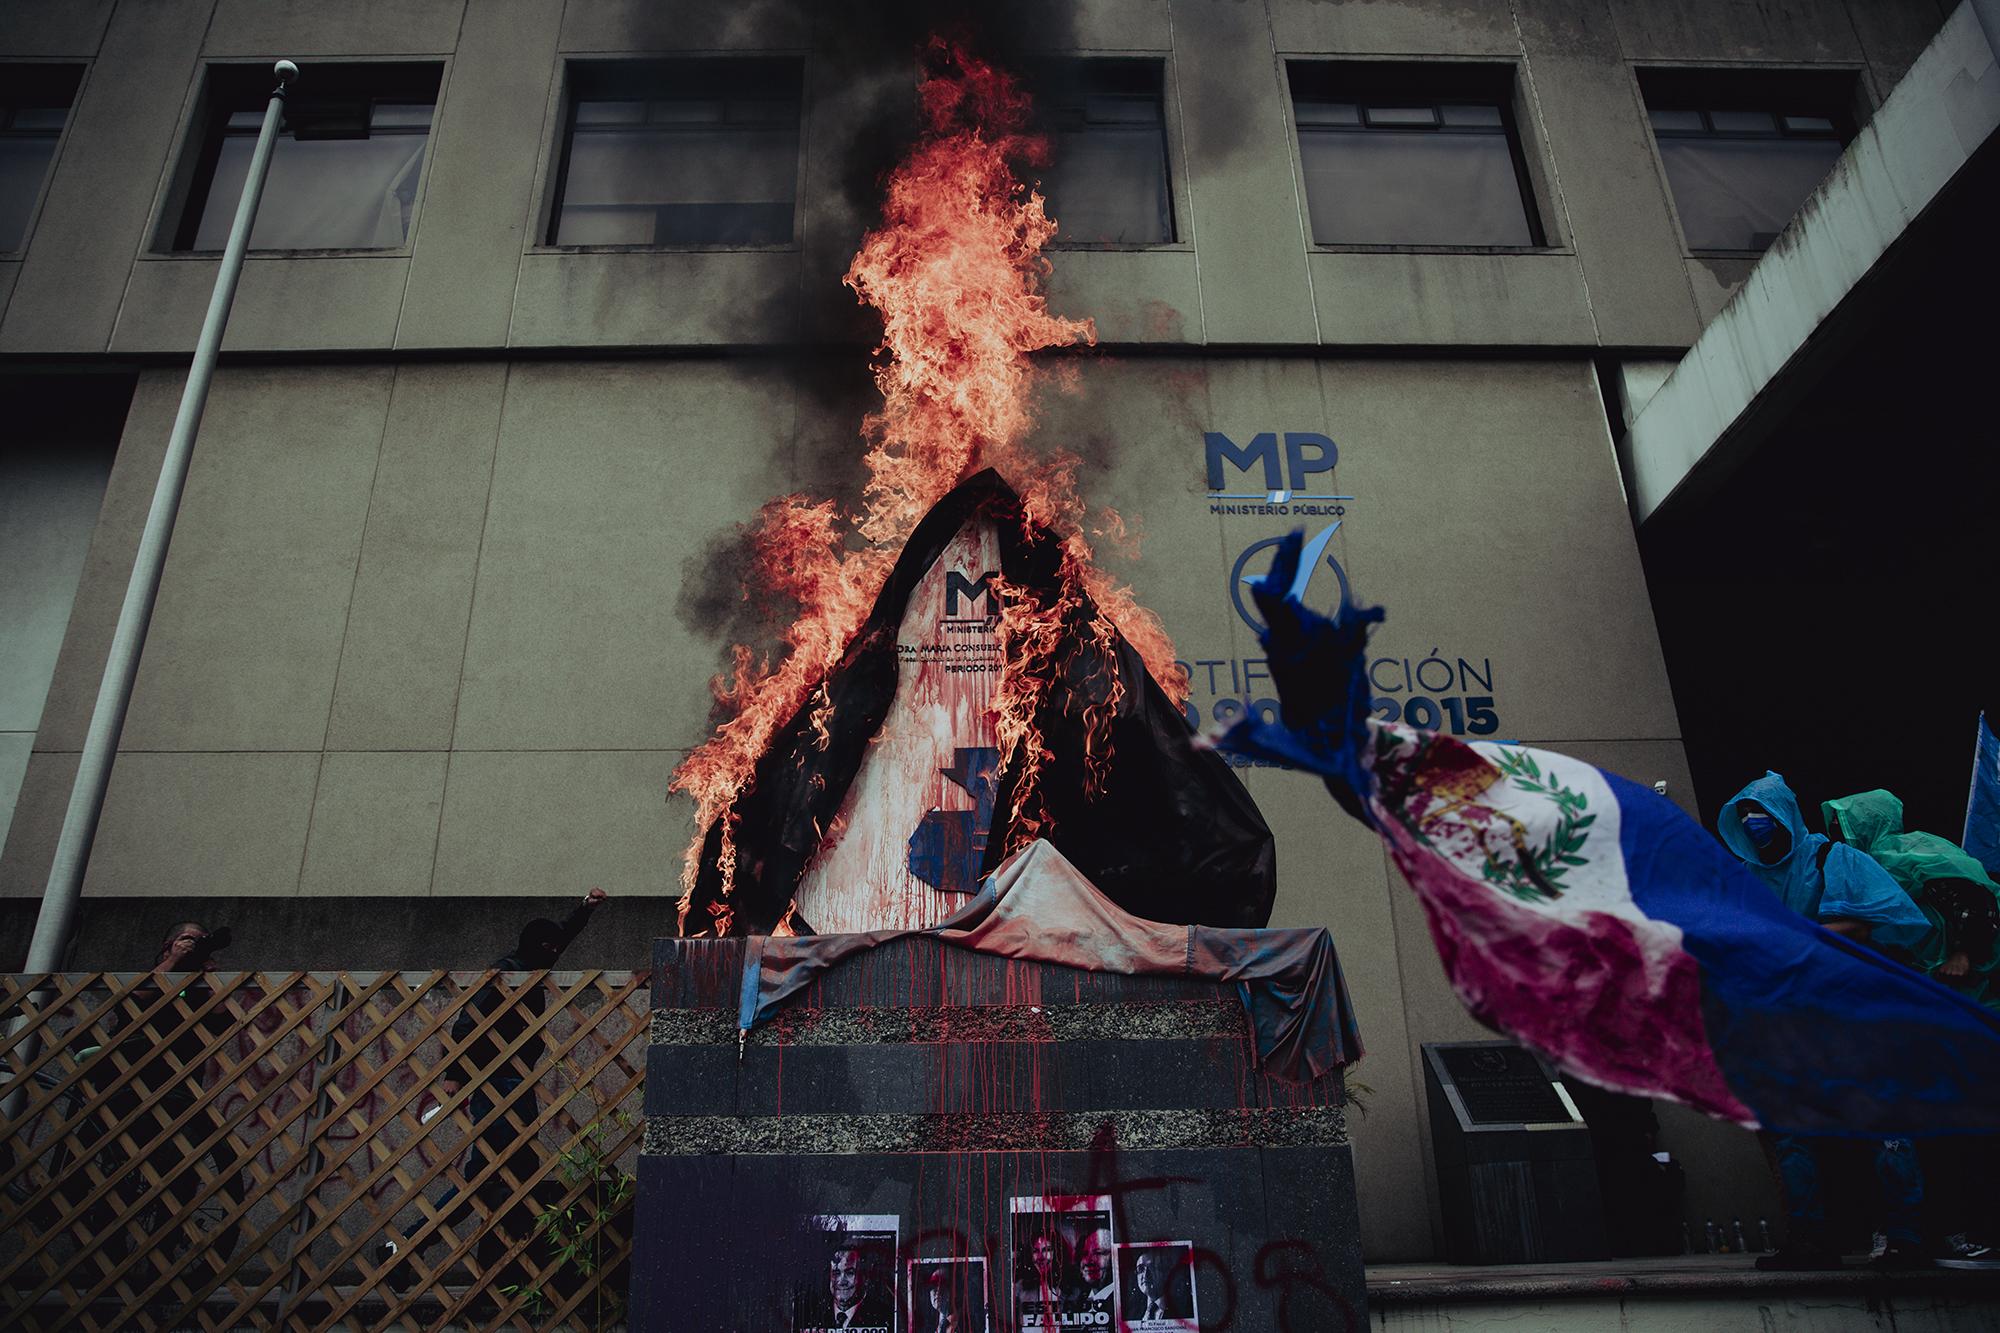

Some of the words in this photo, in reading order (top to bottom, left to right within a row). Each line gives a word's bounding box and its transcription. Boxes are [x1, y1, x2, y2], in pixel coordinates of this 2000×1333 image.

[1204, 432, 1338, 490] MP
[1210, 505, 1289, 516] MINISTERIO
[1293, 503, 1346, 516] PÚBLICO
[945, 664, 986, 673] PERIODO
[988, 664, 1004, 672] 201
[1022, 1312, 1110, 1327] FALLIDO
